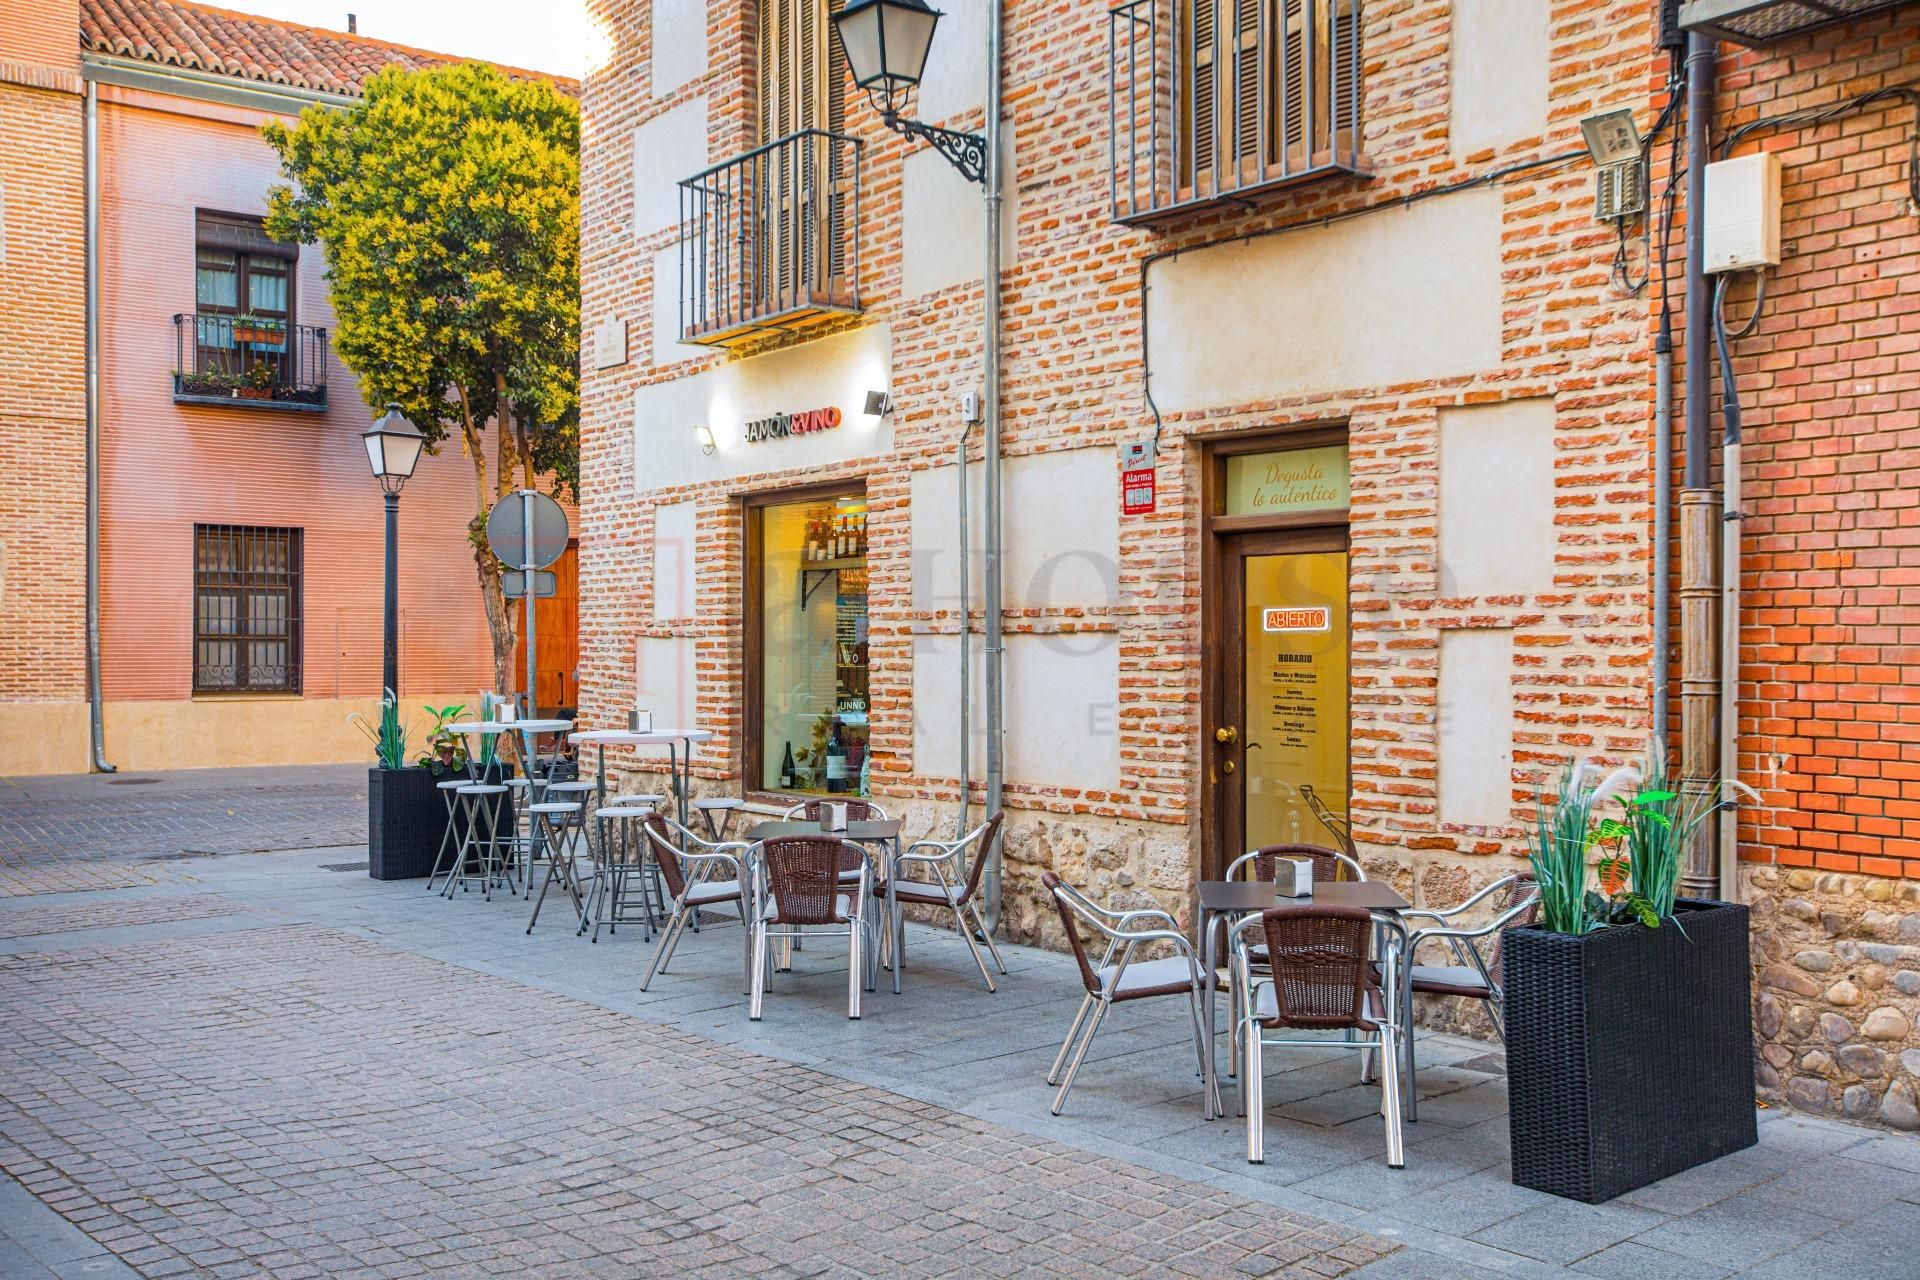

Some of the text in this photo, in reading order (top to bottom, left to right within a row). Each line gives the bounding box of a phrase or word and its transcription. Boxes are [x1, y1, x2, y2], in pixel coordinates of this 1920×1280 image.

[1125, 472, 1152, 483] Alarma
[1265, 462, 1325, 488] Degusta
[1252, 484, 1338, 507] lo auténtico
[1267, 610, 1325, 627] ABIERTO
[1278, 653, 1313, 663] HORARIO
[840, 701, 866, 710] UNNO
